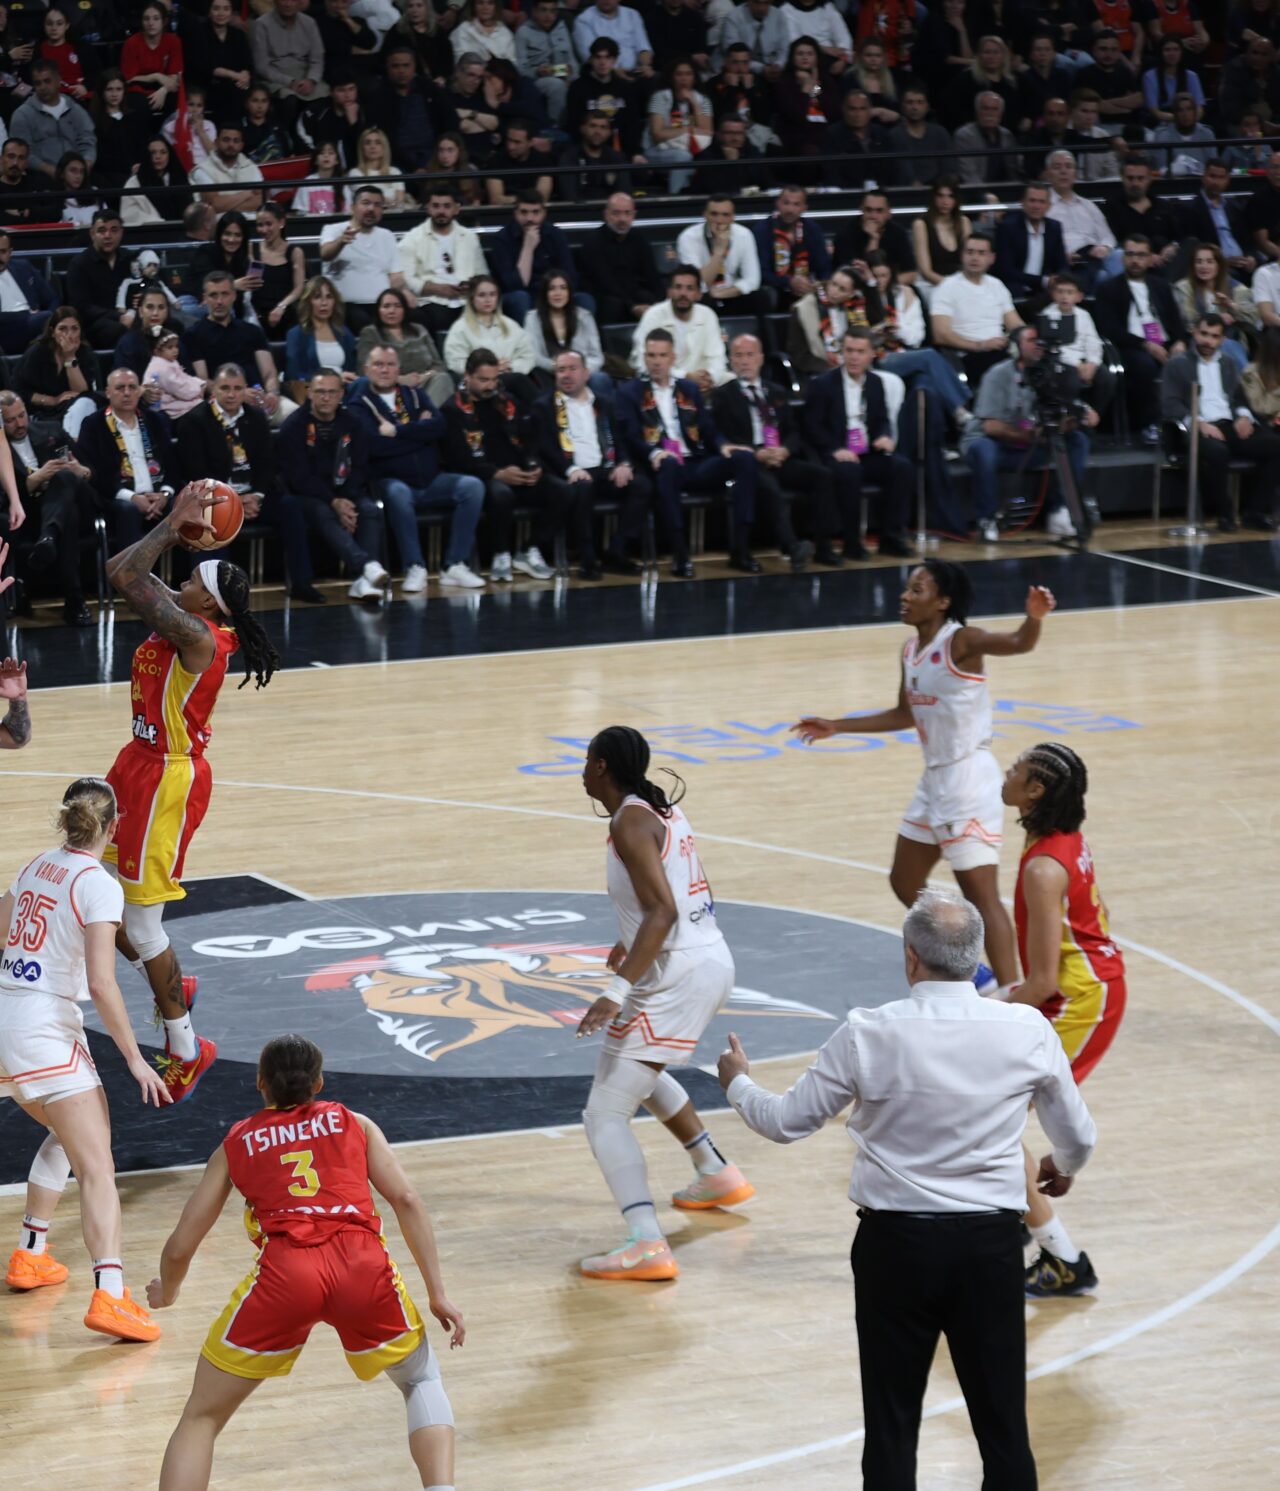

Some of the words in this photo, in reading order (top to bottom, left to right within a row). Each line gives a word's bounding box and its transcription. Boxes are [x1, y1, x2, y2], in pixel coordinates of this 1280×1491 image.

[517, 713, 1145, 776] EUOCUP
[35, 861, 70, 885] VANLOO
[8, 890, 58, 953] 35
[242, 1111, 344, 1157] TSINEKE
[280, 1150, 321, 1197] 3
